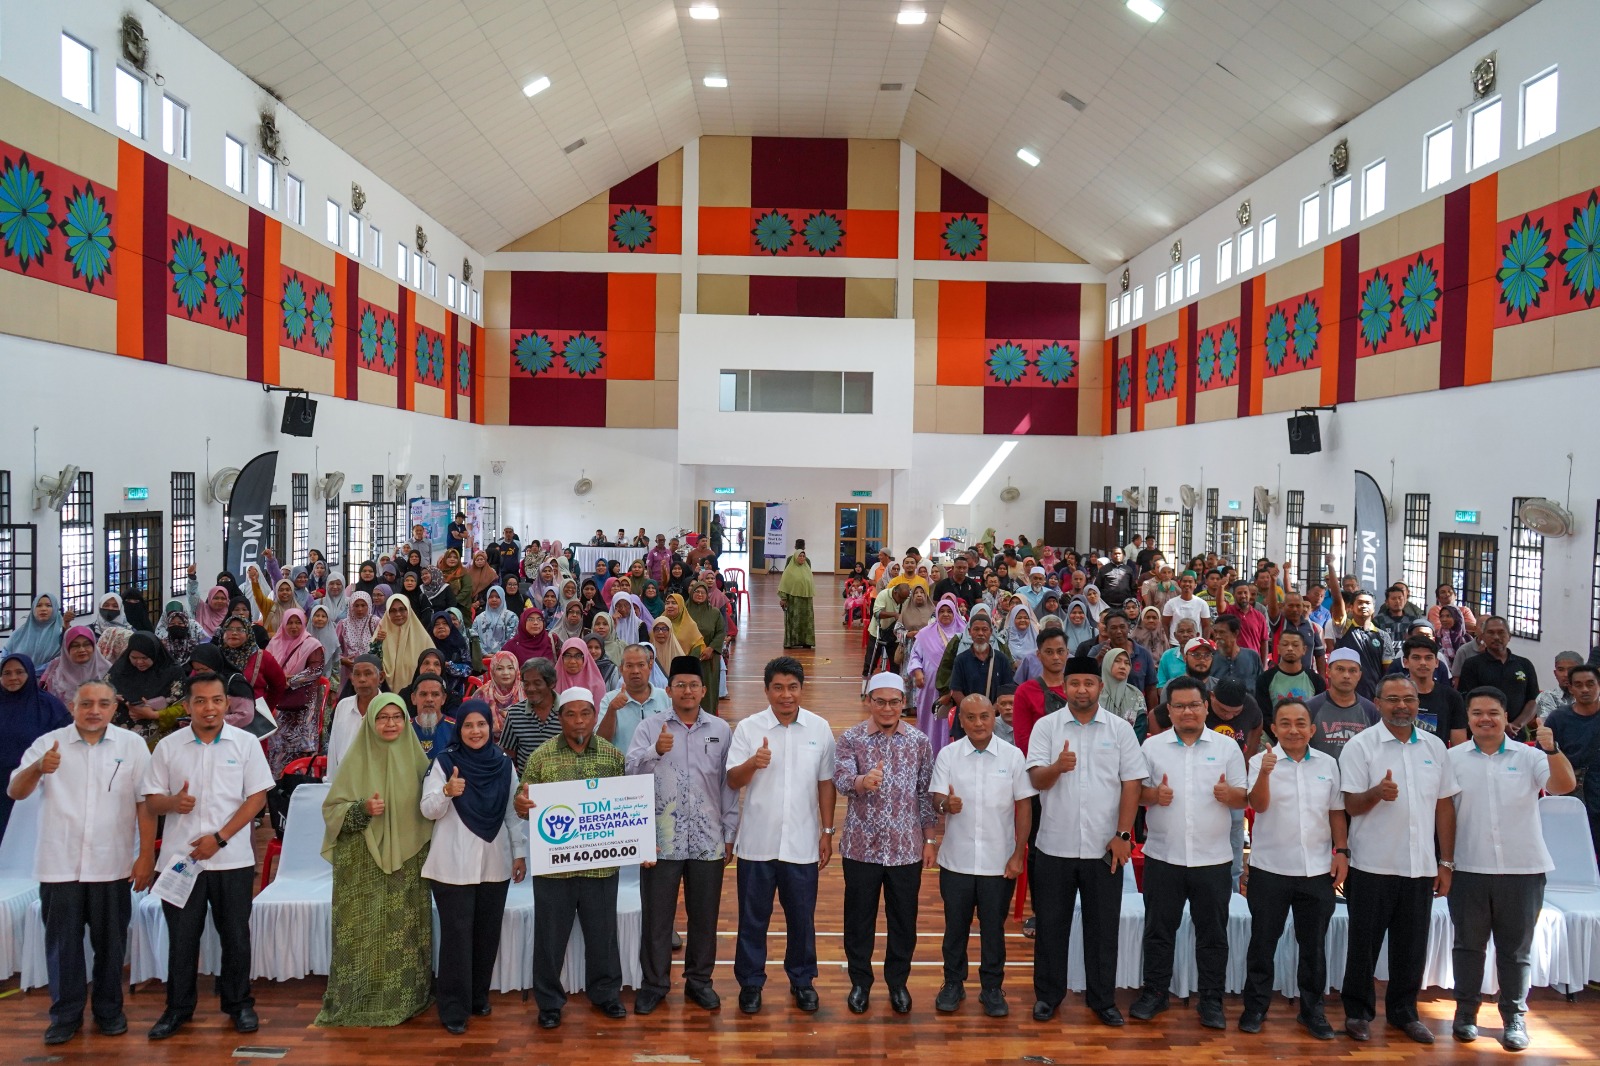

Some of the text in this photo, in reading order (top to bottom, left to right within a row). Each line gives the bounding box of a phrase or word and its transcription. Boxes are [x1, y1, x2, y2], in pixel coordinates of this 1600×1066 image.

[239, 515, 264, 576] TDM
[578, 799, 611, 815] TDM
[579, 812, 629, 824] BERSAMA
[579, 817, 649, 832] MASYARAKAT
[580, 830, 615, 841] TEPOH
[551, 846, 637, 864] RM 40,000.00
